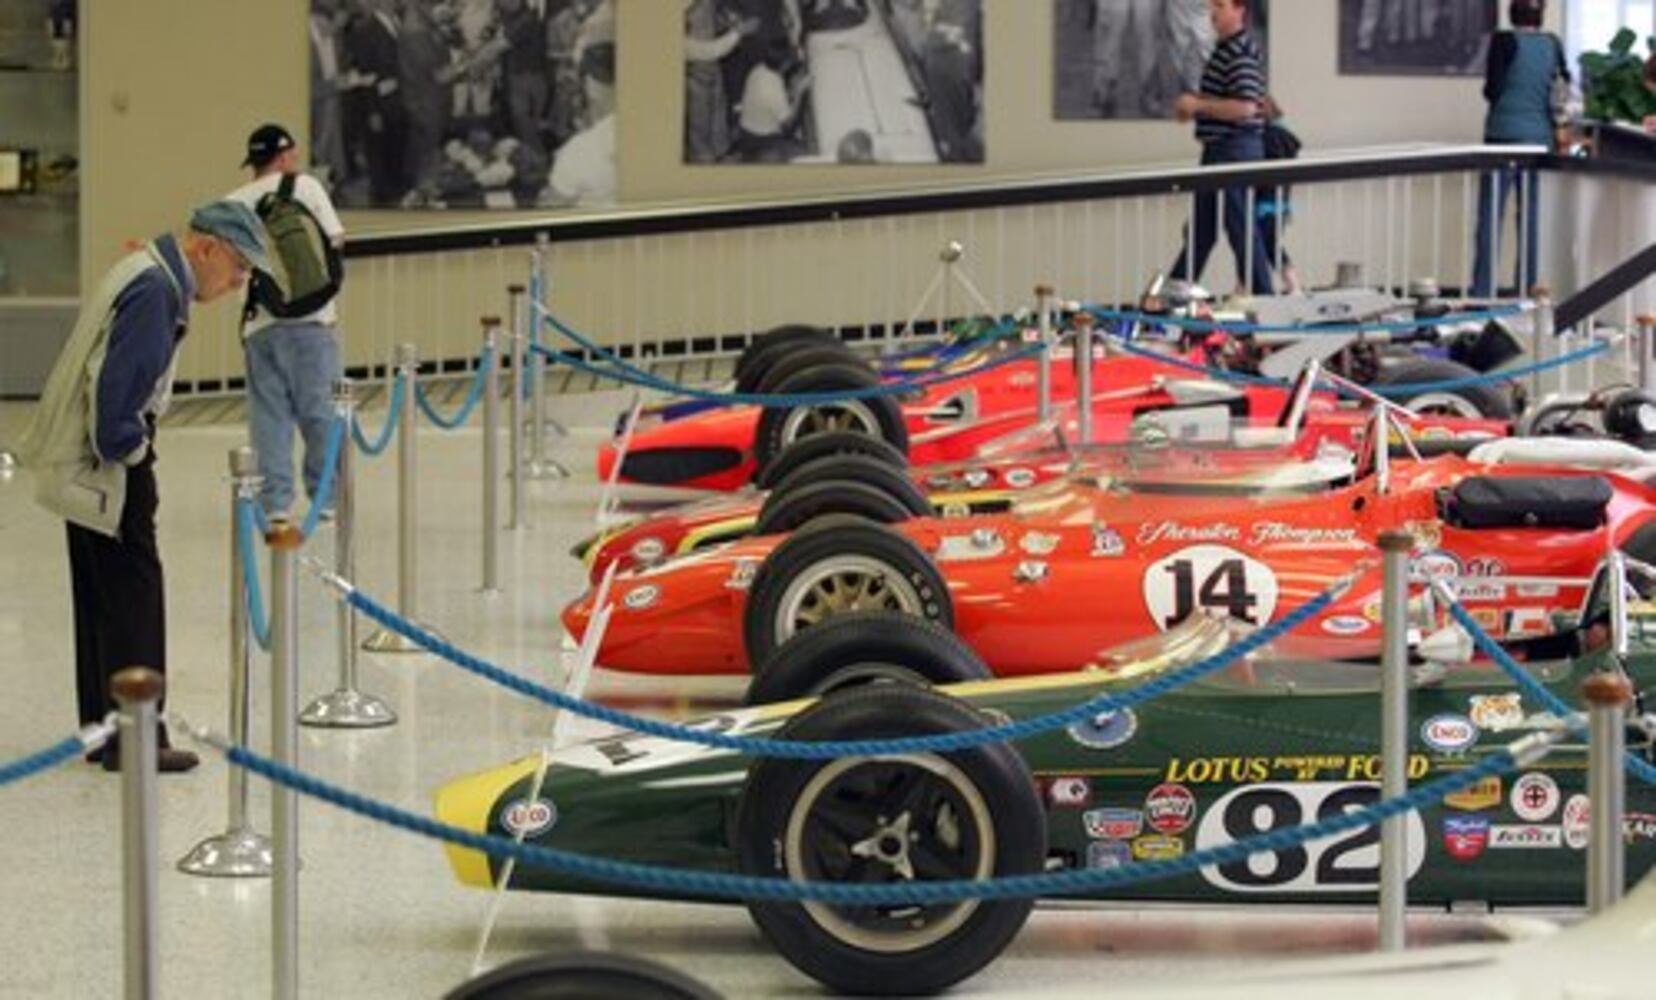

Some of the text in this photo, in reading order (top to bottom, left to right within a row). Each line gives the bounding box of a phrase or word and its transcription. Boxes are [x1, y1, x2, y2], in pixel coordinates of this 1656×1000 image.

[1247, 521, 1356, 545] Thompson
[1164, 559, 1257, 629] 14
[1167, 756, 1269, 782] LOTUS
[1272, 755, 1345, 769] POWERED
[1347, 754, 1429, 780] FOD
[1217, 786, 1384, 886] 82
